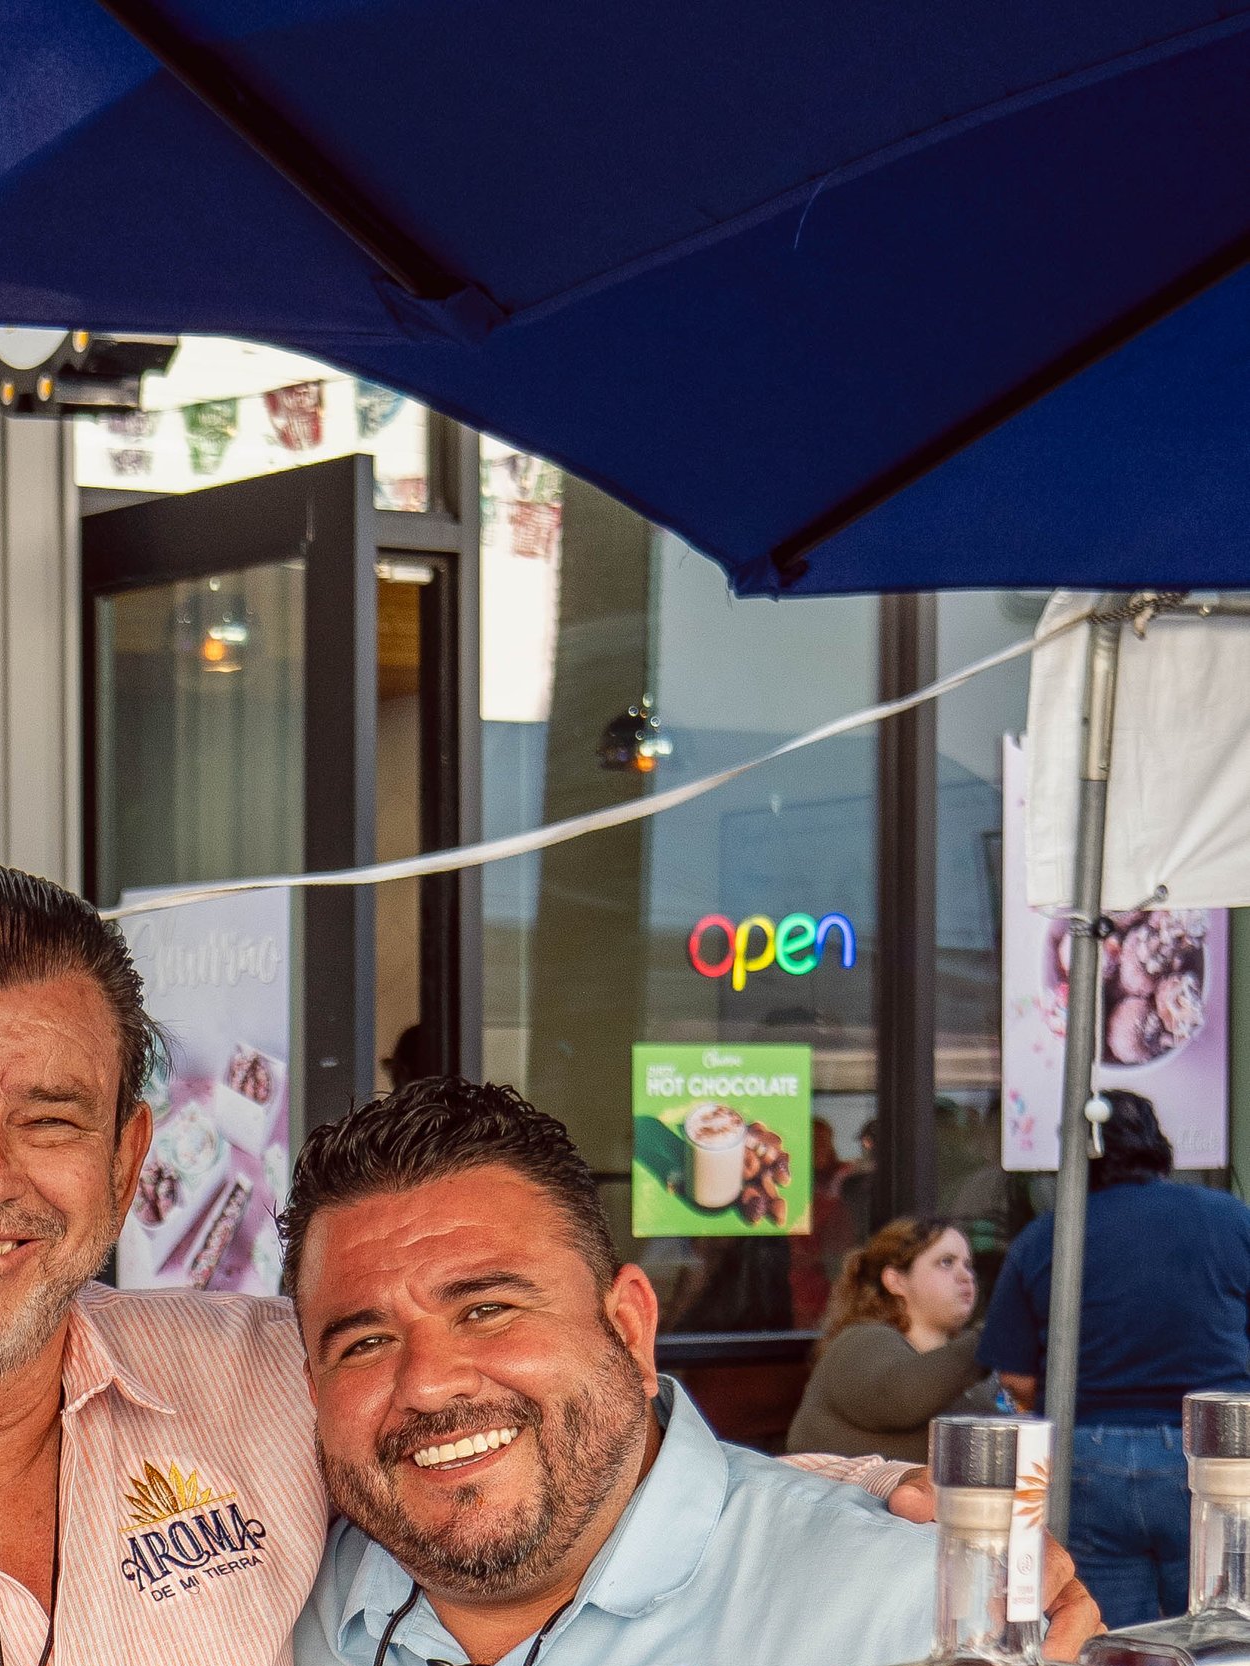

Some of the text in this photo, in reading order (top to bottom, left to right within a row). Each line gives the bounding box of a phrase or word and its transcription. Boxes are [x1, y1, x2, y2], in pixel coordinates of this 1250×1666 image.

[689, 912, 857, 992] open
[646, 1074, 799, 1098] HOT CHOCOLATE
[121, 1503, 266, 1592] AROMA
[151, 1555, 264, 1602] DE MI TIERRA
